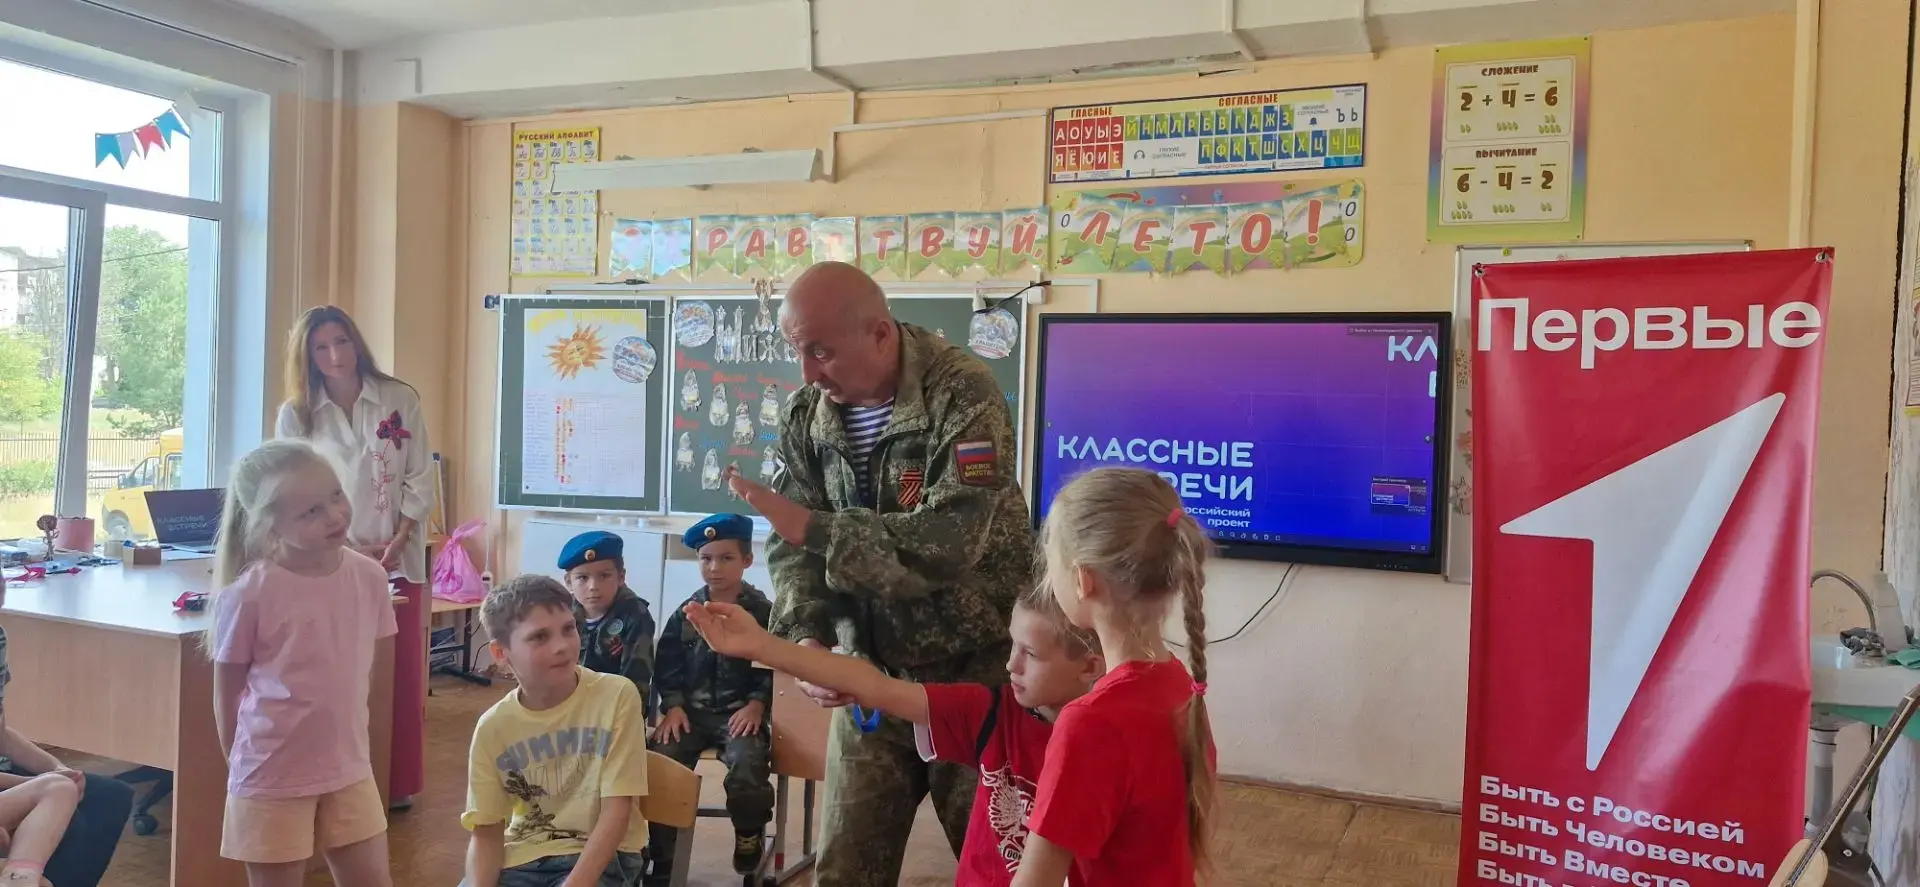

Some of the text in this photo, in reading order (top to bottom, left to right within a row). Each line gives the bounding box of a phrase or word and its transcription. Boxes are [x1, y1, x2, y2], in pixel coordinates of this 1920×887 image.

[1481, 65, 1539, 76] СЛОЖЕНИЕ
[1218, 93, 1279, 107] СОГЛАСНЫЕ
[1460, 86, 1558, 111] 2 + 4 = 6
[1070, 107, 1113, 118] ГЛАСНЫЕ
[1336, 108, 1345, 123] Ъ
[1351, 107, 1358, 122] Ь
[1055, 128, 1065, 141] А
[1070, 127, 1080, 140] О
[1085, 126, 1094, 140] У
[1097, 125, 1108, 139] Ы
[1113, 124, 1122, 138] Э
[1127, 120, 1136, 137] Й
[1156, 121, 1167, 134] М
[1171, 120, 1181, 133] Л
[1187, 119, 1196, 132] Р
[1203, 117, 1212, 131] Б
[1218, 116, 1226, 130] В
[1235, 115, 1242, 129] Г
[1250, 114, 1259, 129] Д
[1265, 113, 1276, 127] Ж
[1282, 113, 1290, 127] З
[1216, 143, 1227, 156] Ф
[1249, 141, 1257, 155] Т
[1263, 140, 1275, 154] Ш
[1297, 138, 1305, 152] Х
[1314, 137, 1323, 154] Ц
[1347, 134, 1360, 150] Щ
[1476, 148, 1538, 159] ВЫЧИТАНИЕ
[1055, 149, 1120, 167] Я Ё Ю И Е
[1456, 173, 1470, 193] 6
[1498, 172, 1513, 190] 4
[1521, 176, 1532, 185] =
[1541, 170, 1554, 190] 2
[1079, 199, 1322, 256] ЛЕТО!
[1477, 297, 1821, 369] Первые
[1057, 435, 1254, 468] КЛАССНЫЕ
[1184, 506, 1251, 517] оссийский
[1207, 518, 1251, 528] проект
[1480, 775, 1744, 845] Быть с Россией
[1479, 803, 1765, 879] Быть Человеком
[1478, 831, 1691, 887] Быть Вместе
[1477, 859, 1554, 887] Быть
